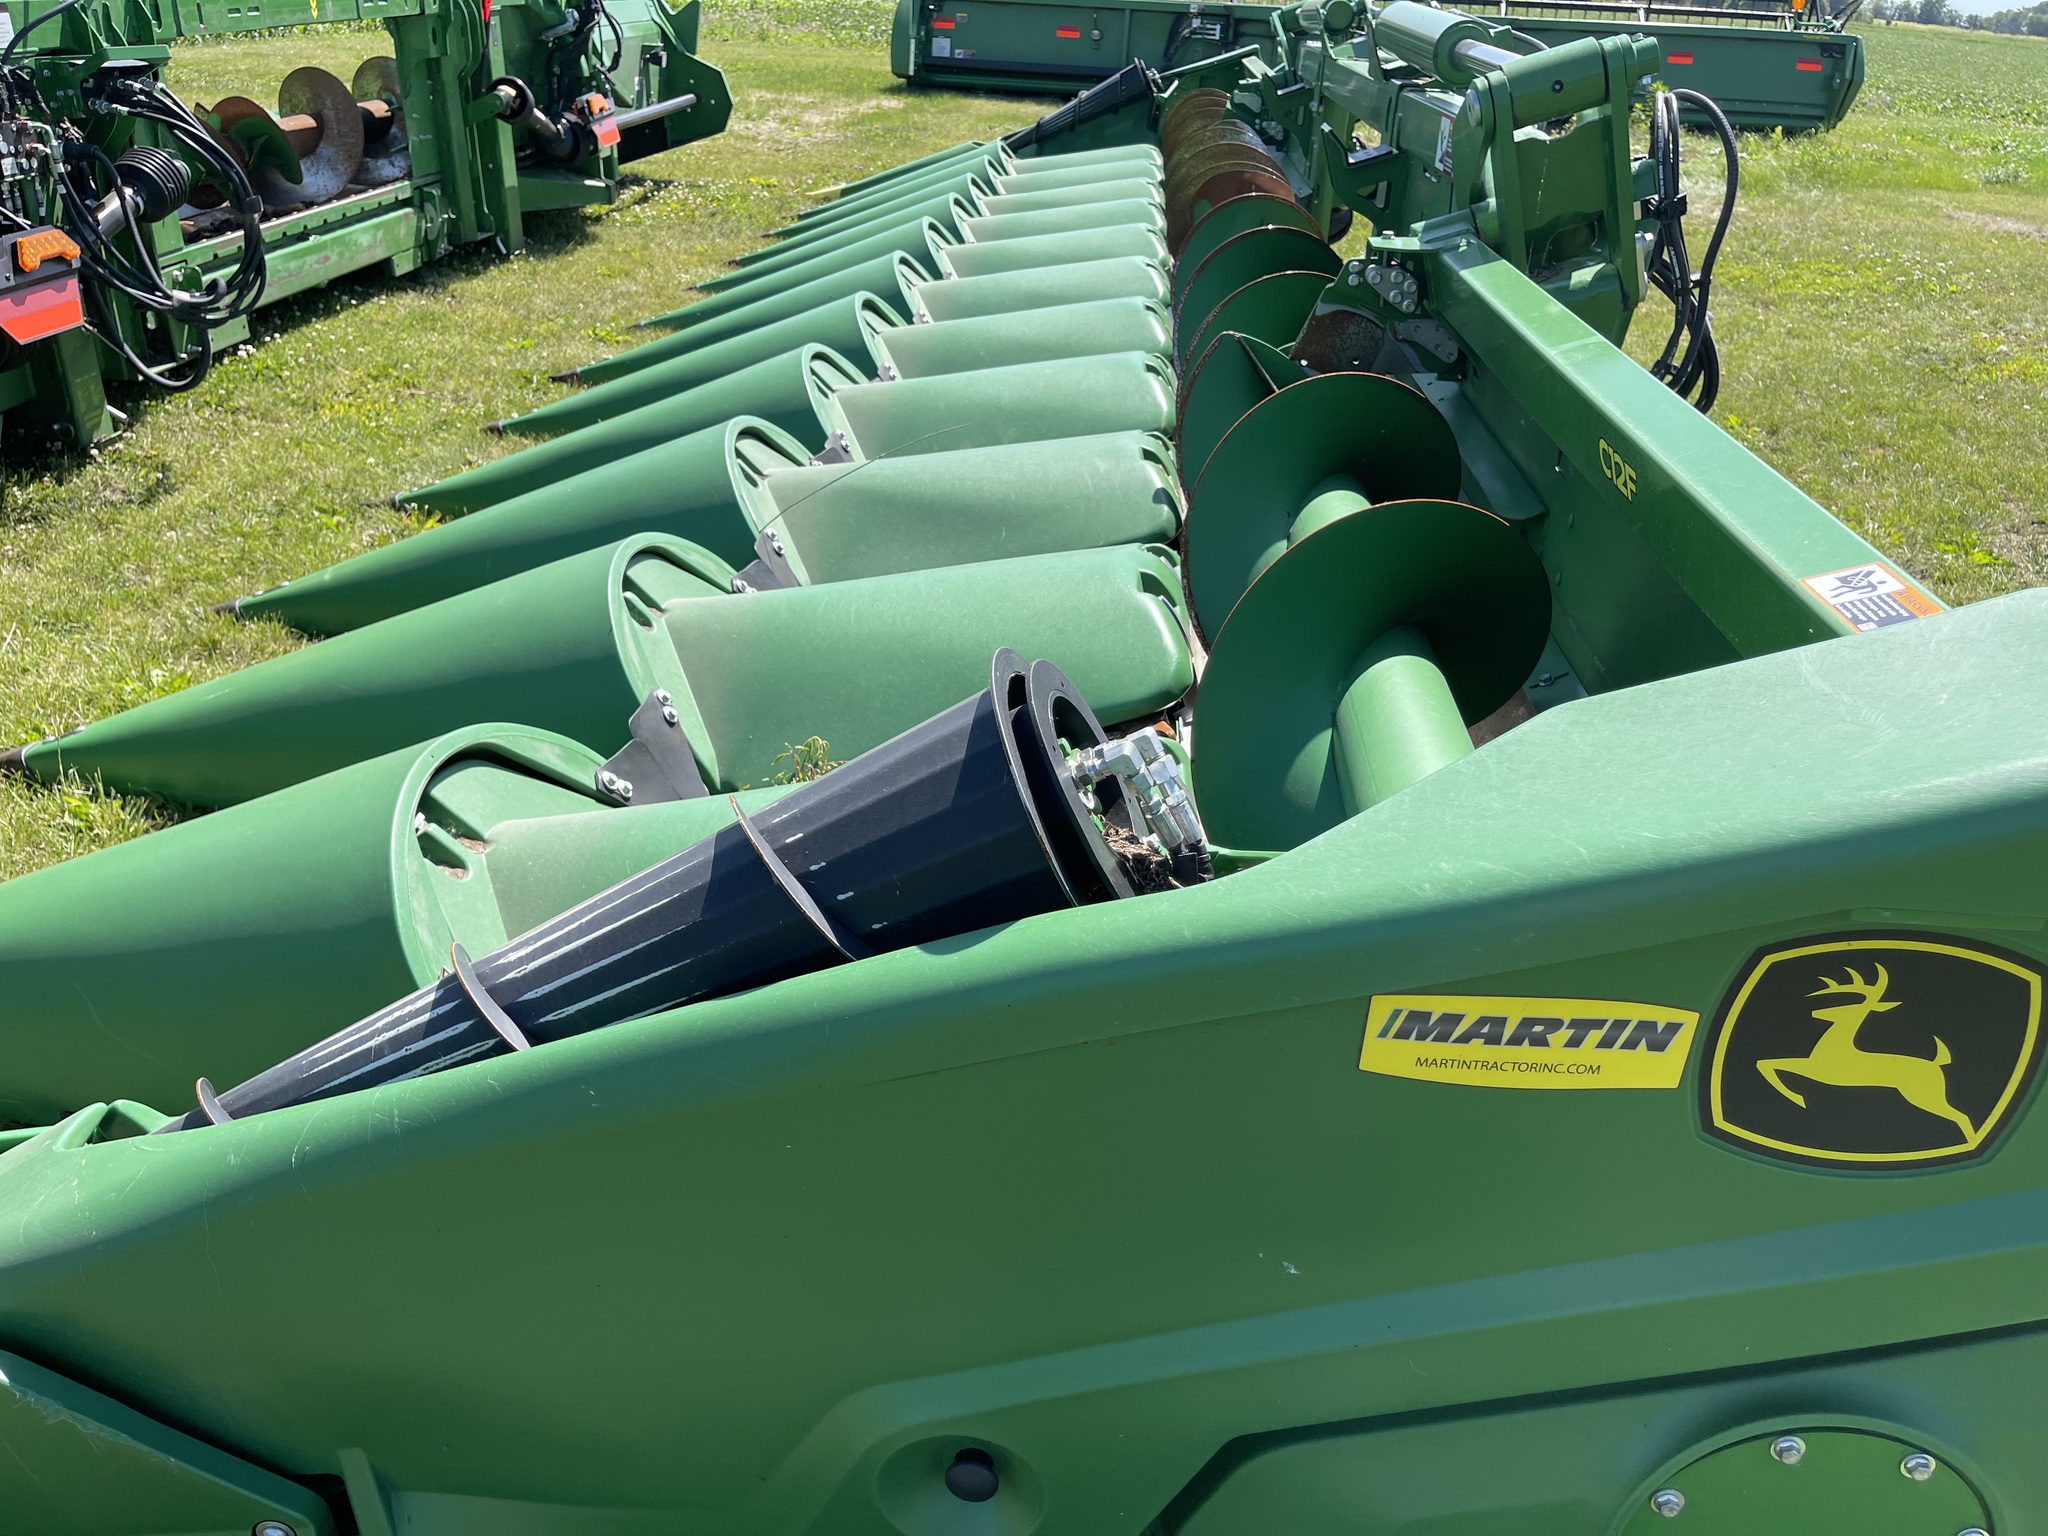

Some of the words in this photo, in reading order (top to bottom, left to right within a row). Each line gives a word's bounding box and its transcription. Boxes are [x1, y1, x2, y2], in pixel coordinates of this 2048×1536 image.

[1598, 438, 1637, 502] C12F
[1391, 1010, 1686, 1053] MARTIN
[1415, 1057, 1601, 1076] MARTINTRACTORINC.COM
